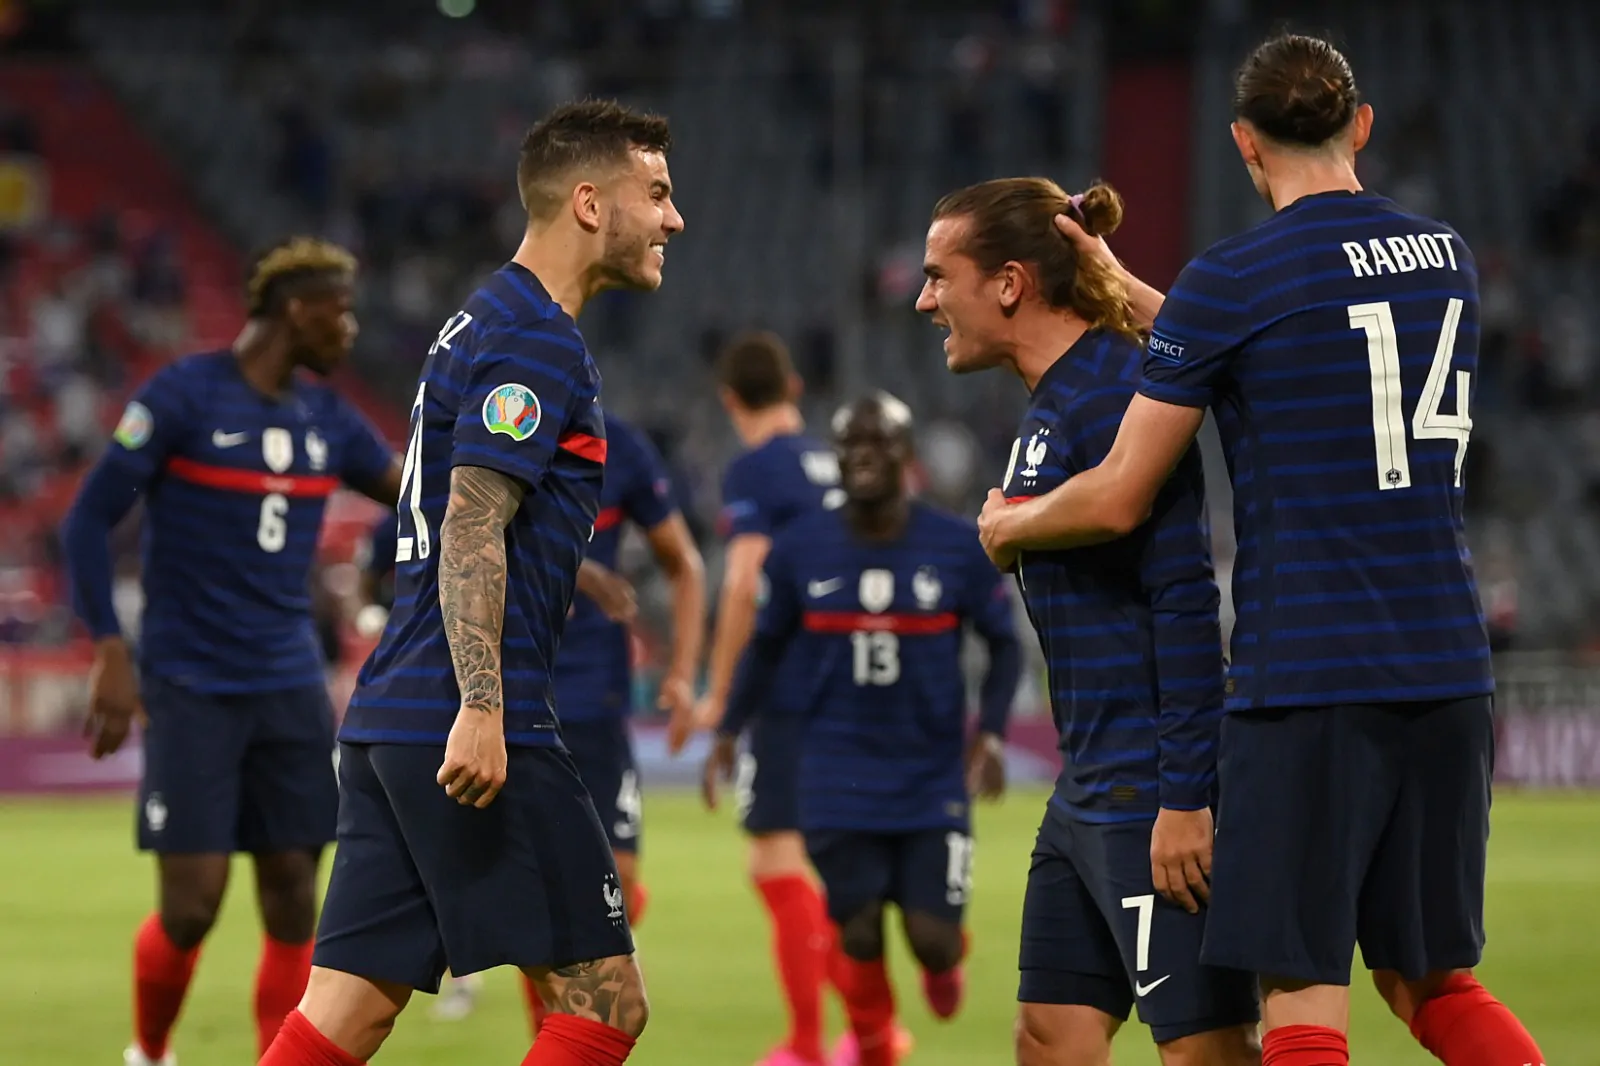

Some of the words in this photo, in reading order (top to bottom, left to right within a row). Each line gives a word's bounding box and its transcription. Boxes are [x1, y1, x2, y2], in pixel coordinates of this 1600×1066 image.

[1342, 233, 1458, 277] RABIOT
[1347, 298, 1473, 490] 14
[257, 492, 288, 553] 6
[850, 630, 900, 686] 13
[1121, 894, 1155, 971] 7
